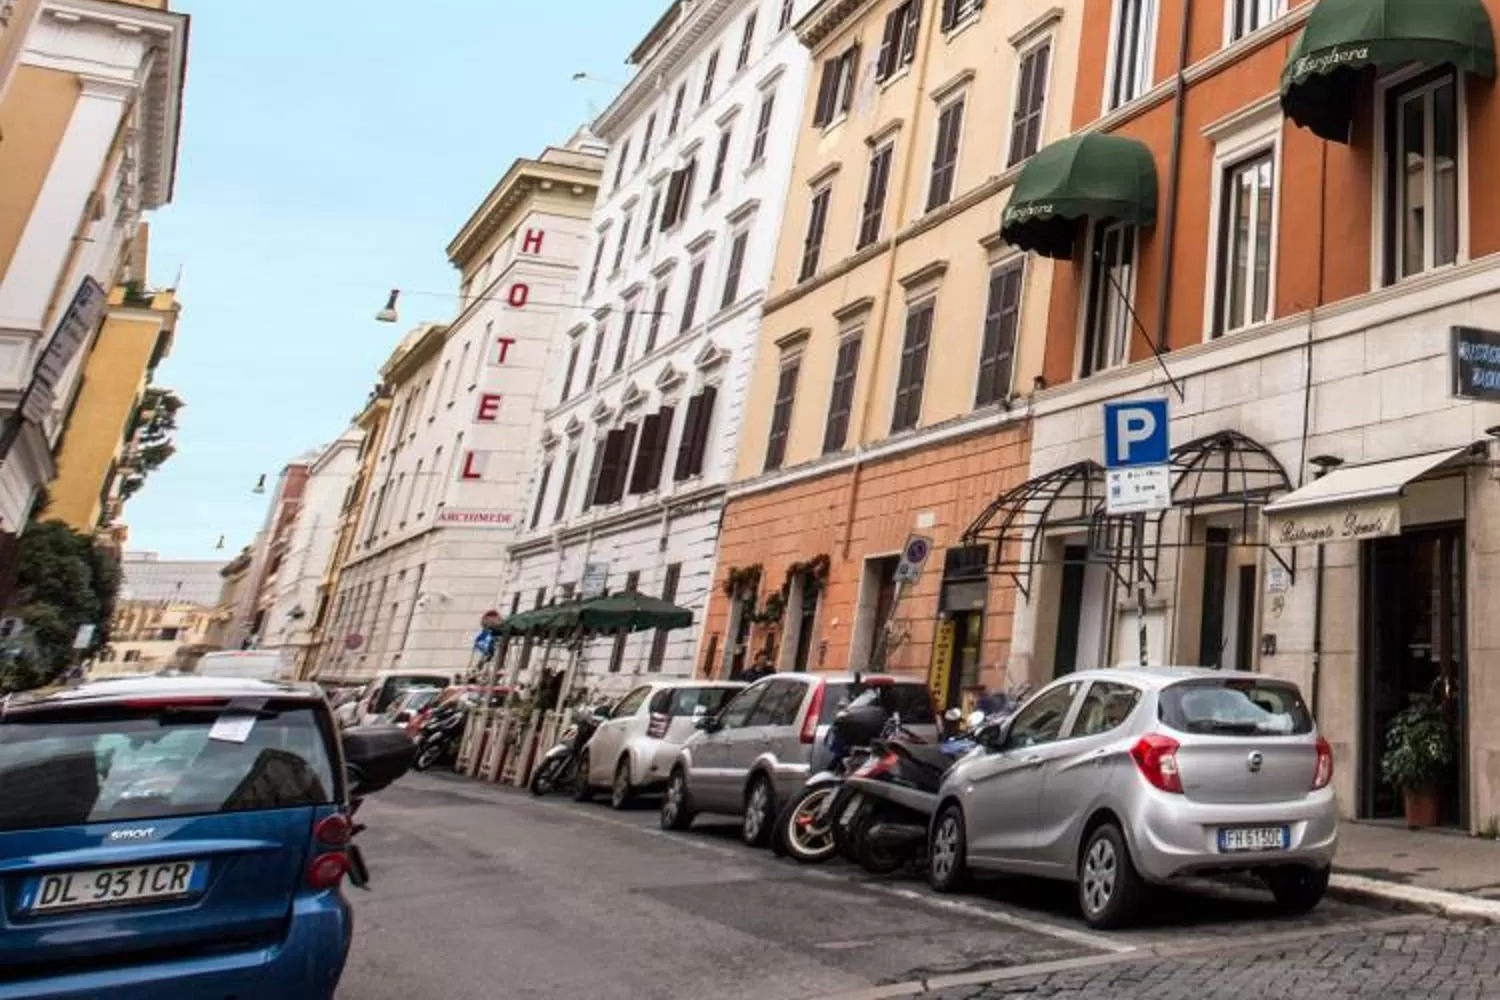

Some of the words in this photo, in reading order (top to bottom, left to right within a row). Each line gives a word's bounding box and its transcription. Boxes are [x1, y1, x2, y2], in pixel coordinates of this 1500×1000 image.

[461, 228, 544, 479] HOTEL
[1117, 408, 1156, 460] P
[1280, 519, 1335, 542] Ristorante
[110, 827, 156, 841] smart
[39, 876, 79, 906] DL
[92, 862, 190, 900] 931CR
